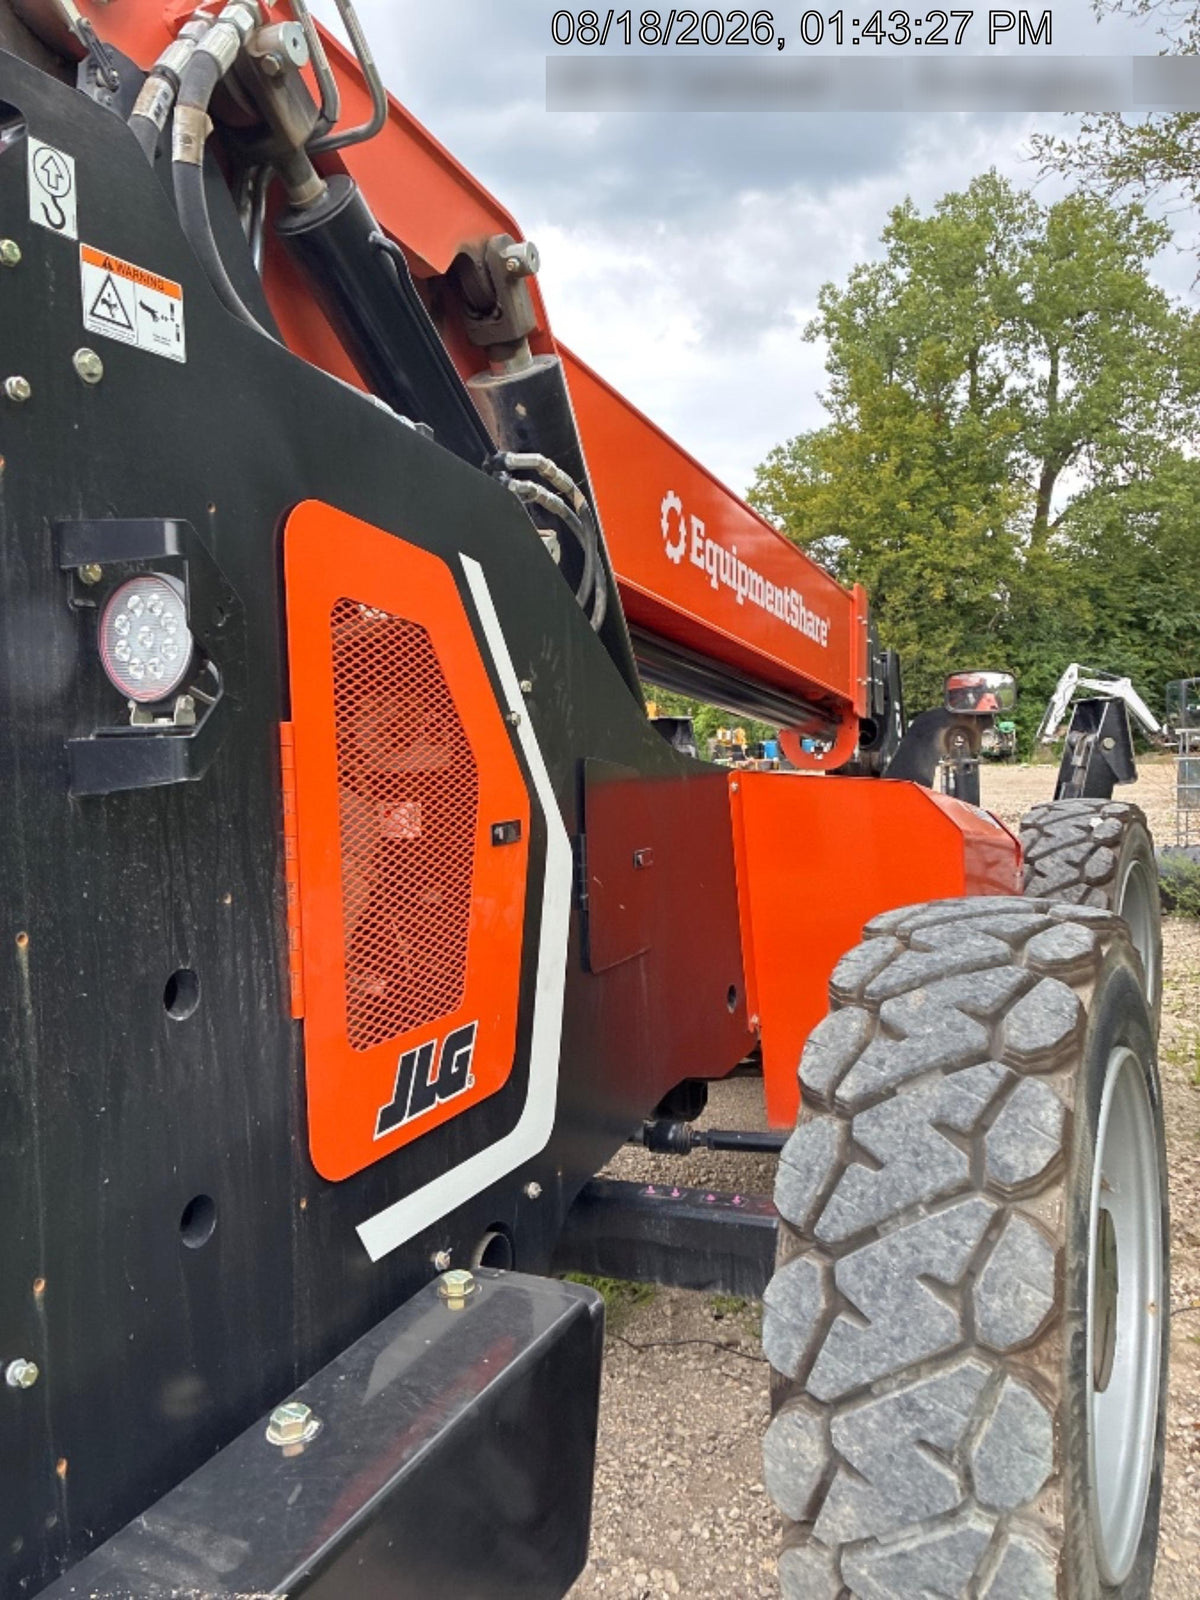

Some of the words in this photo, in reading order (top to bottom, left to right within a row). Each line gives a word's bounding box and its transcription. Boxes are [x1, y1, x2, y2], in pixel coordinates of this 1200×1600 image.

[116, 262, 165, 291] WARNING
[690, 514, 828, 648] EquipmentShare
[373, 1020, 478, 1141] JLG
